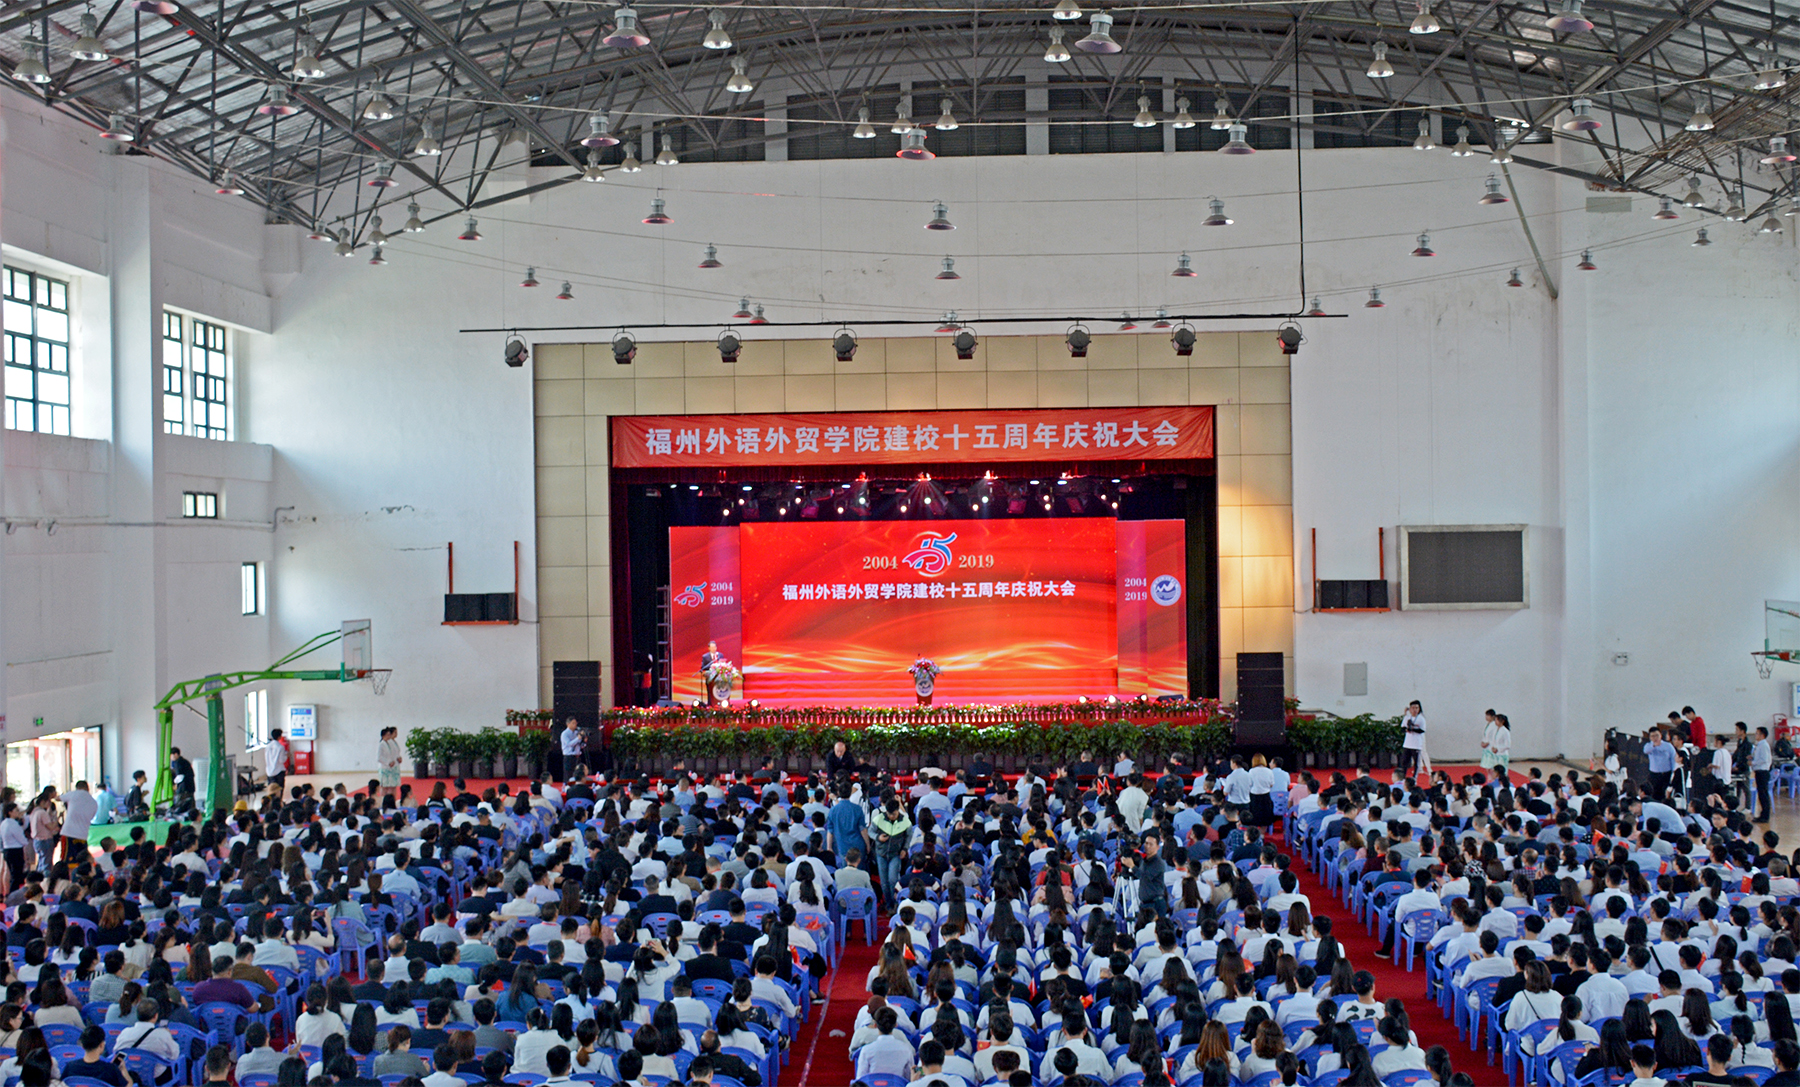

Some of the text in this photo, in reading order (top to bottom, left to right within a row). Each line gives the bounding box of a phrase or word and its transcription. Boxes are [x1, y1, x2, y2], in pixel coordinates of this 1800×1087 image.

[645, 420, 1179, 455] 福州外语外贸学院建校十五周年庆祝大会
[862, 556, 898, 570] 2004
[958, 554, 995, 568] 2019
[710, 582, 733, 591] 2004
[1124, 578, 1147, 587] 2004
[782, 580, 1076, 600] 福州外语外贸学院建校十五周年庆祝大会
[710, 596, 734, 605] 2019
[1124, 592, 1147, 601] 2019
